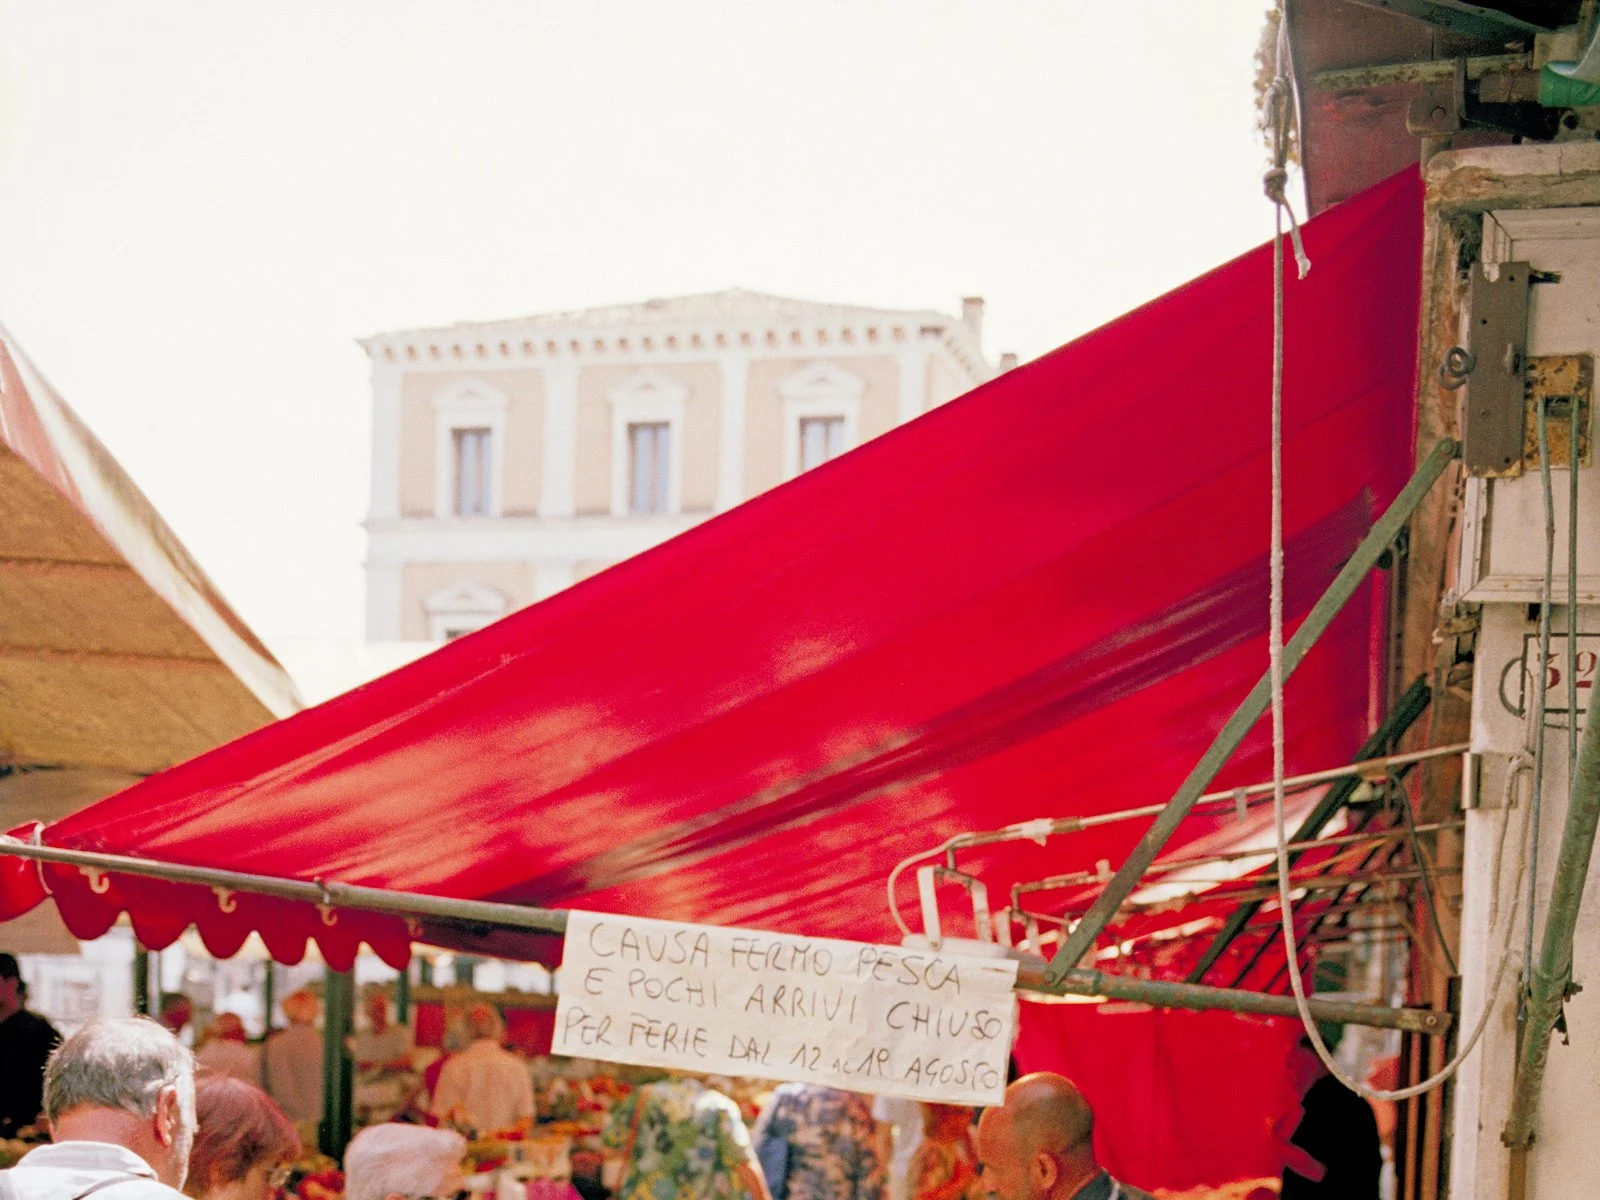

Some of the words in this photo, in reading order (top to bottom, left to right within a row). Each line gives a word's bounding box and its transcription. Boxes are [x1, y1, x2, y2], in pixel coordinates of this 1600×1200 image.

[589, 922, 709, 968] CAUSA
[731, 937, 833, 976] FERMO
[856, 947, 961, 995] PESCA
[584, 967, 613, 995] E
[628, 968, 718, 1008] POCHI
[745, 984, 857, 1025] ARRIVI
[886, 1001, 1002, 1041] CHIUSO
[562, 1006, 613, 1046] PER
[629, 1012, 708, 1057] FERIE
[728, 1034, 772, 1066] DAL
[789, 1043, 821, 1072] 12
[905, 1057, 998, 1091] AGOSTO
